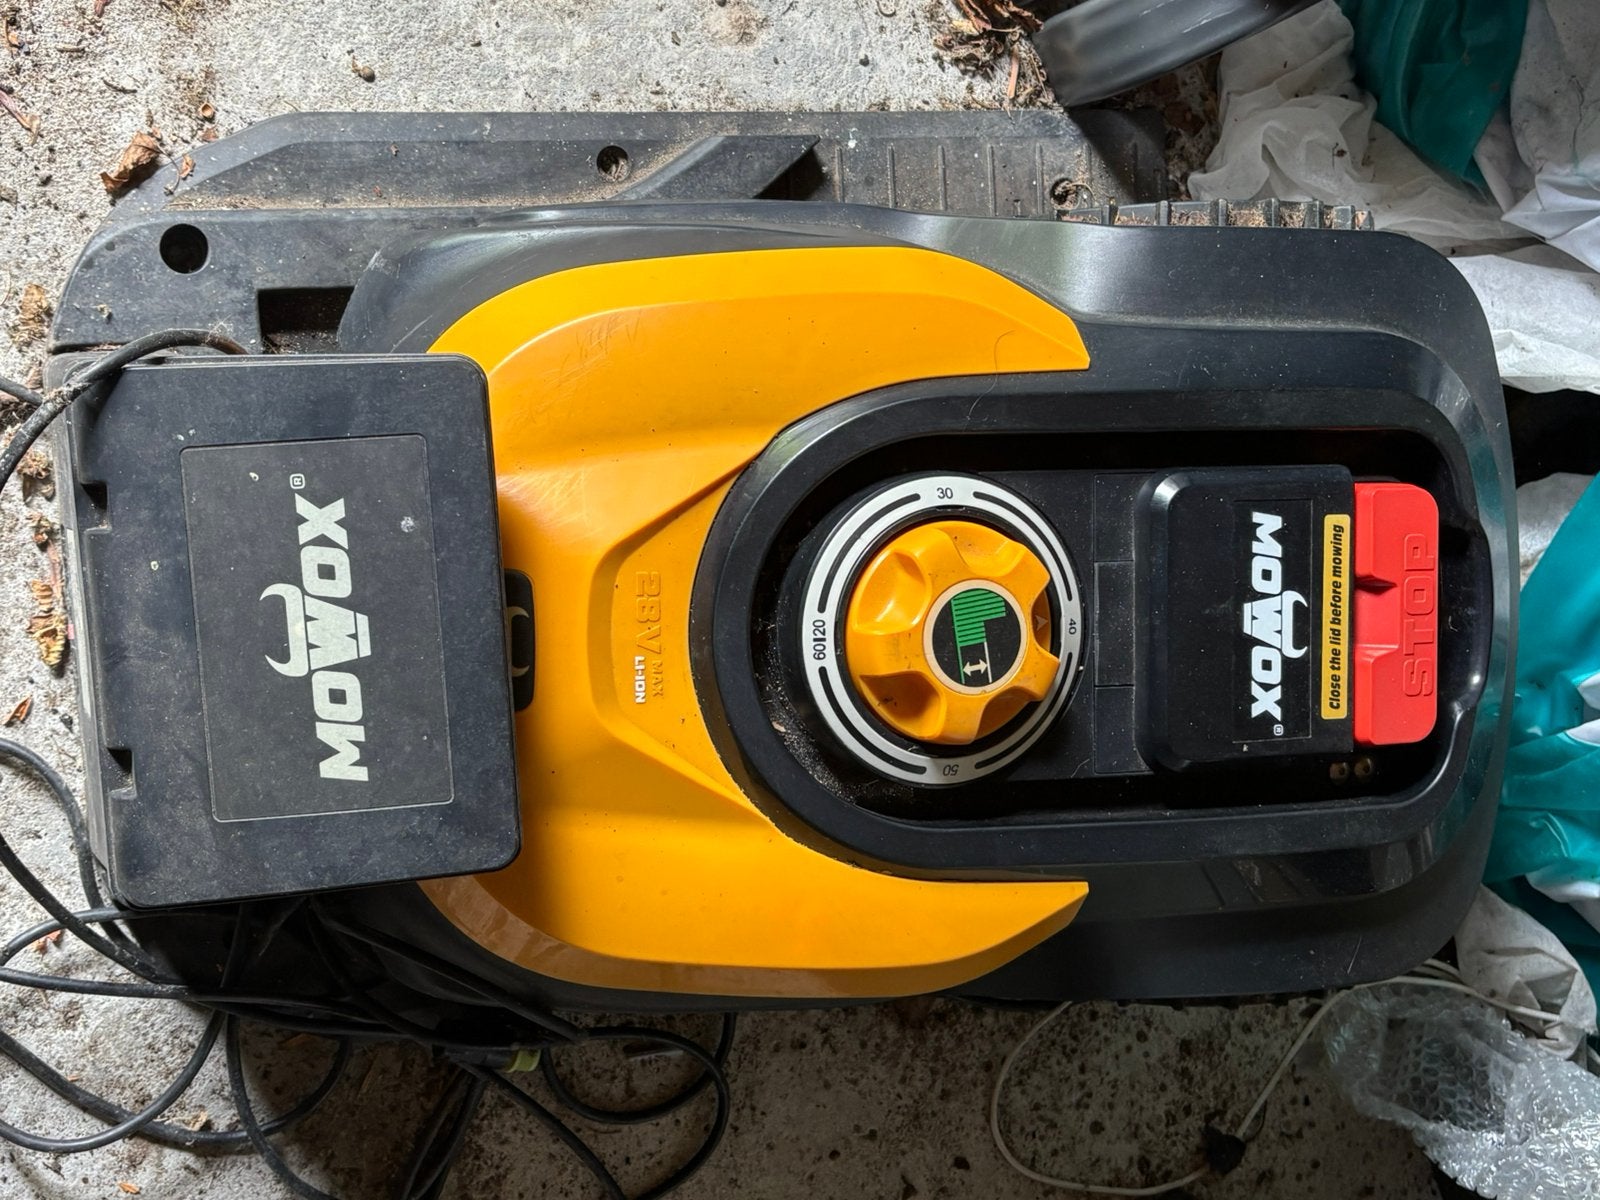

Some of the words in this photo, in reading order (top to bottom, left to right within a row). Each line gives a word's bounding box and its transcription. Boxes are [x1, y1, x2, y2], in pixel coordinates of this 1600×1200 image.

[936, 486, 953, 499] 30
[1330, 524, 1344, 578] mowing
[1329, 581, 1342, 626] before
[1402, 533, 1434, 697] STOP
[1068, 618, 1077, 635] 40
[1328, 627, 1341, 645] lid
[1328, 648, 1341, 671] the
[634, 656, 646, 703] LI-ION
[652, 660, 664, 697] MAX
[1328, 674, 1341, 710] Close
[942, 764, 960, 776] 50
